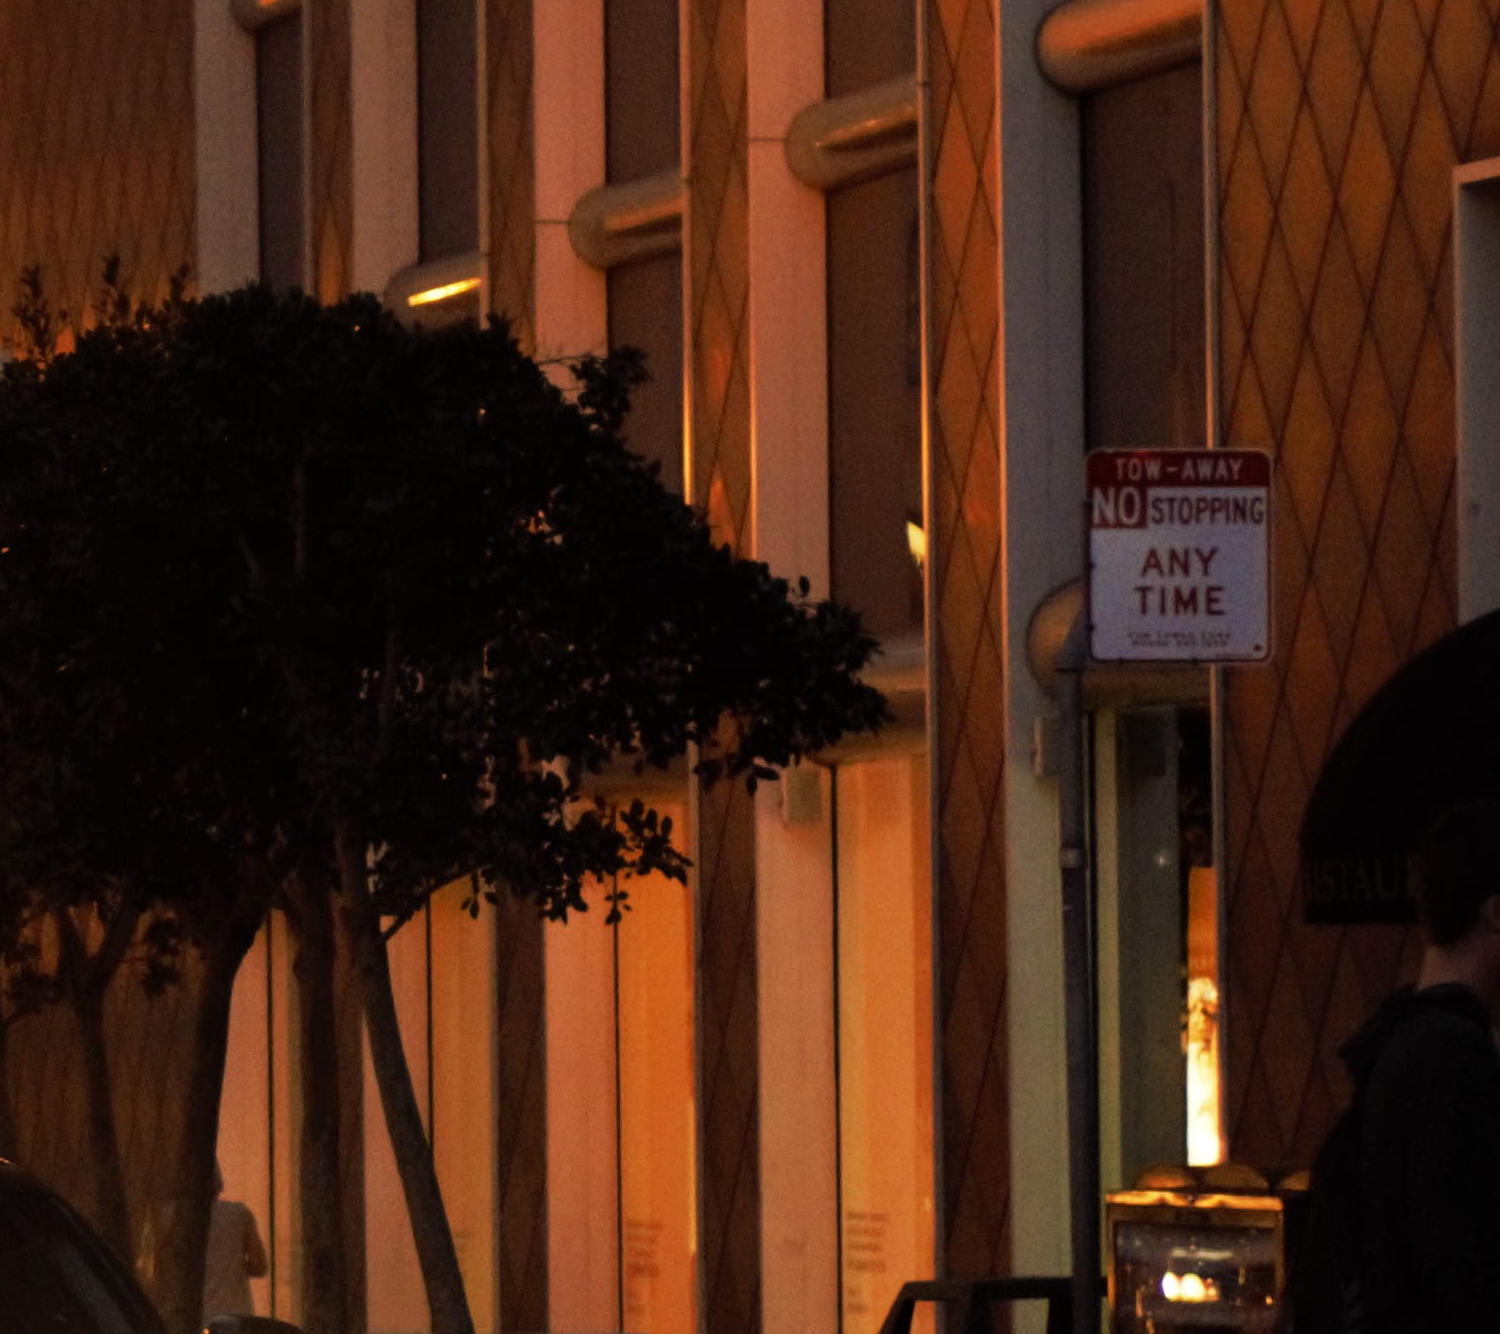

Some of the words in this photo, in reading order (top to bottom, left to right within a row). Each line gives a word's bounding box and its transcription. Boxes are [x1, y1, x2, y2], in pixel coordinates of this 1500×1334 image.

[1114, 457, 1244, 483] TOW-AWAY
[1091, 484, 1143, 526] NO
[1152, 497, 1265, 526] STOPPING
[1141, 547, 1218, 578] ANY
[1134, 586, 1226, 617] TIME
